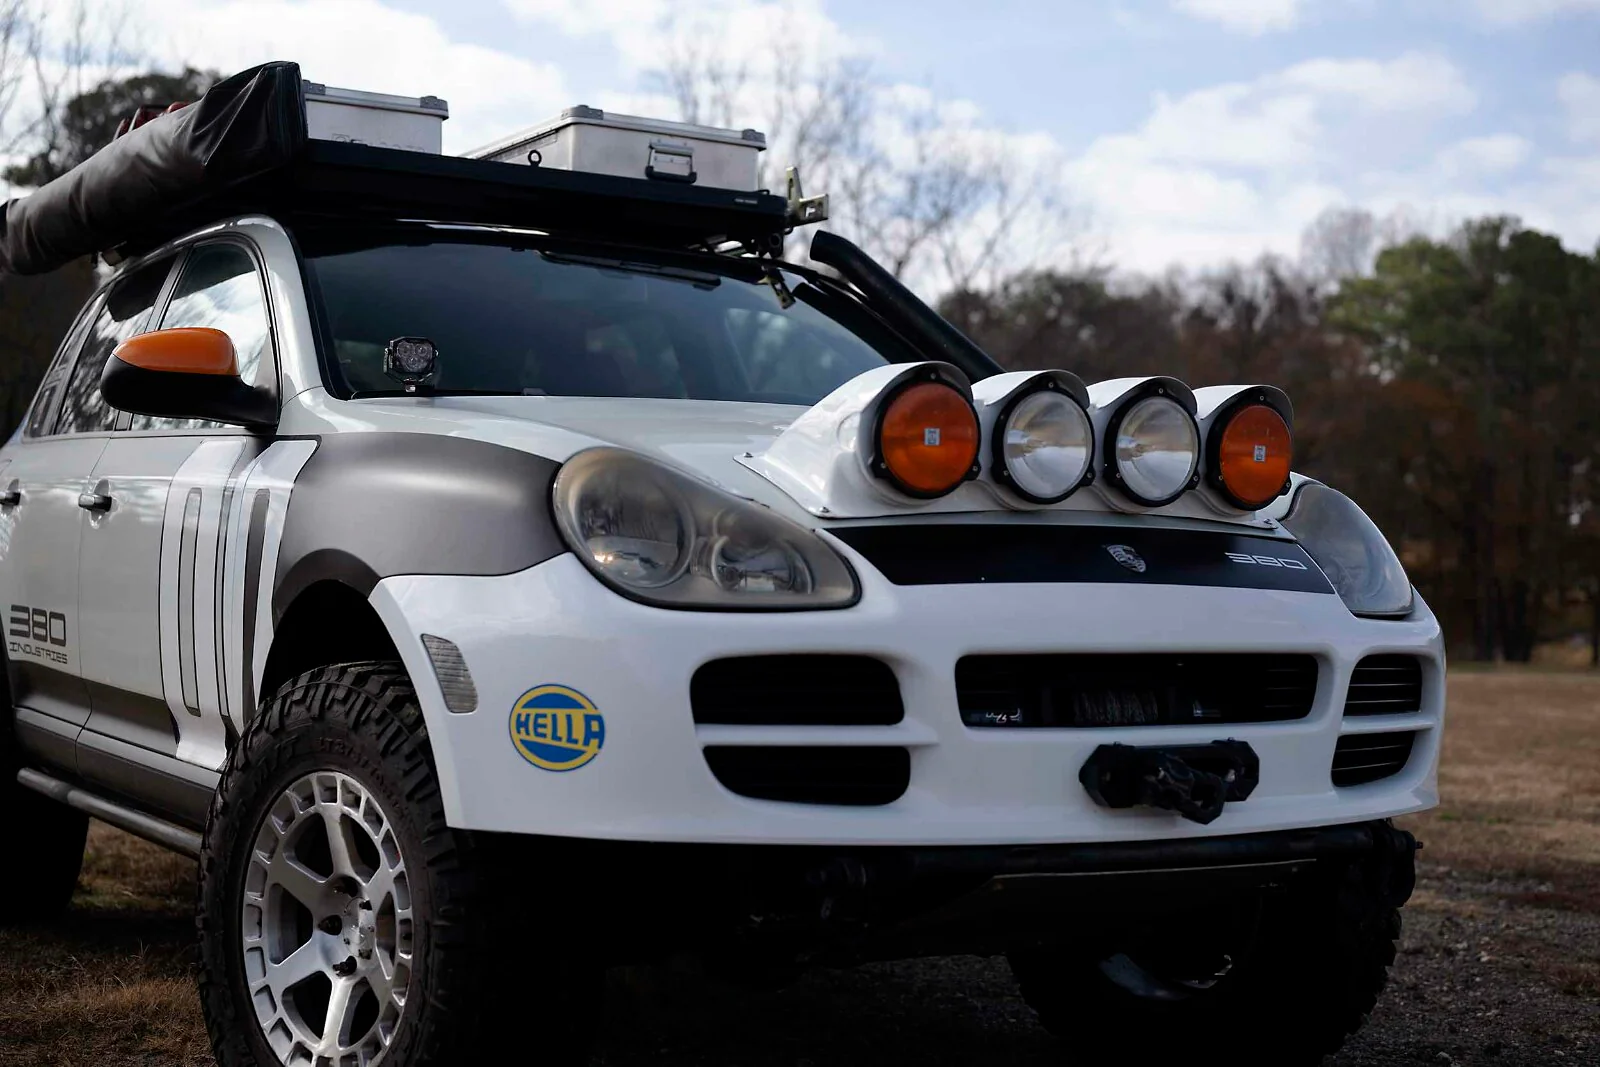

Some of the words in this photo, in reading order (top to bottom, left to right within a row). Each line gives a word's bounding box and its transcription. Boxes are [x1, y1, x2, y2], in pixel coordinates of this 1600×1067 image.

[1224, 552, 1308, 570] 380
[10, 604, 67, 647] 380
[9, 641, 68, 665] INDUSTRIES
[515, 712, 605, 750] HELLA
